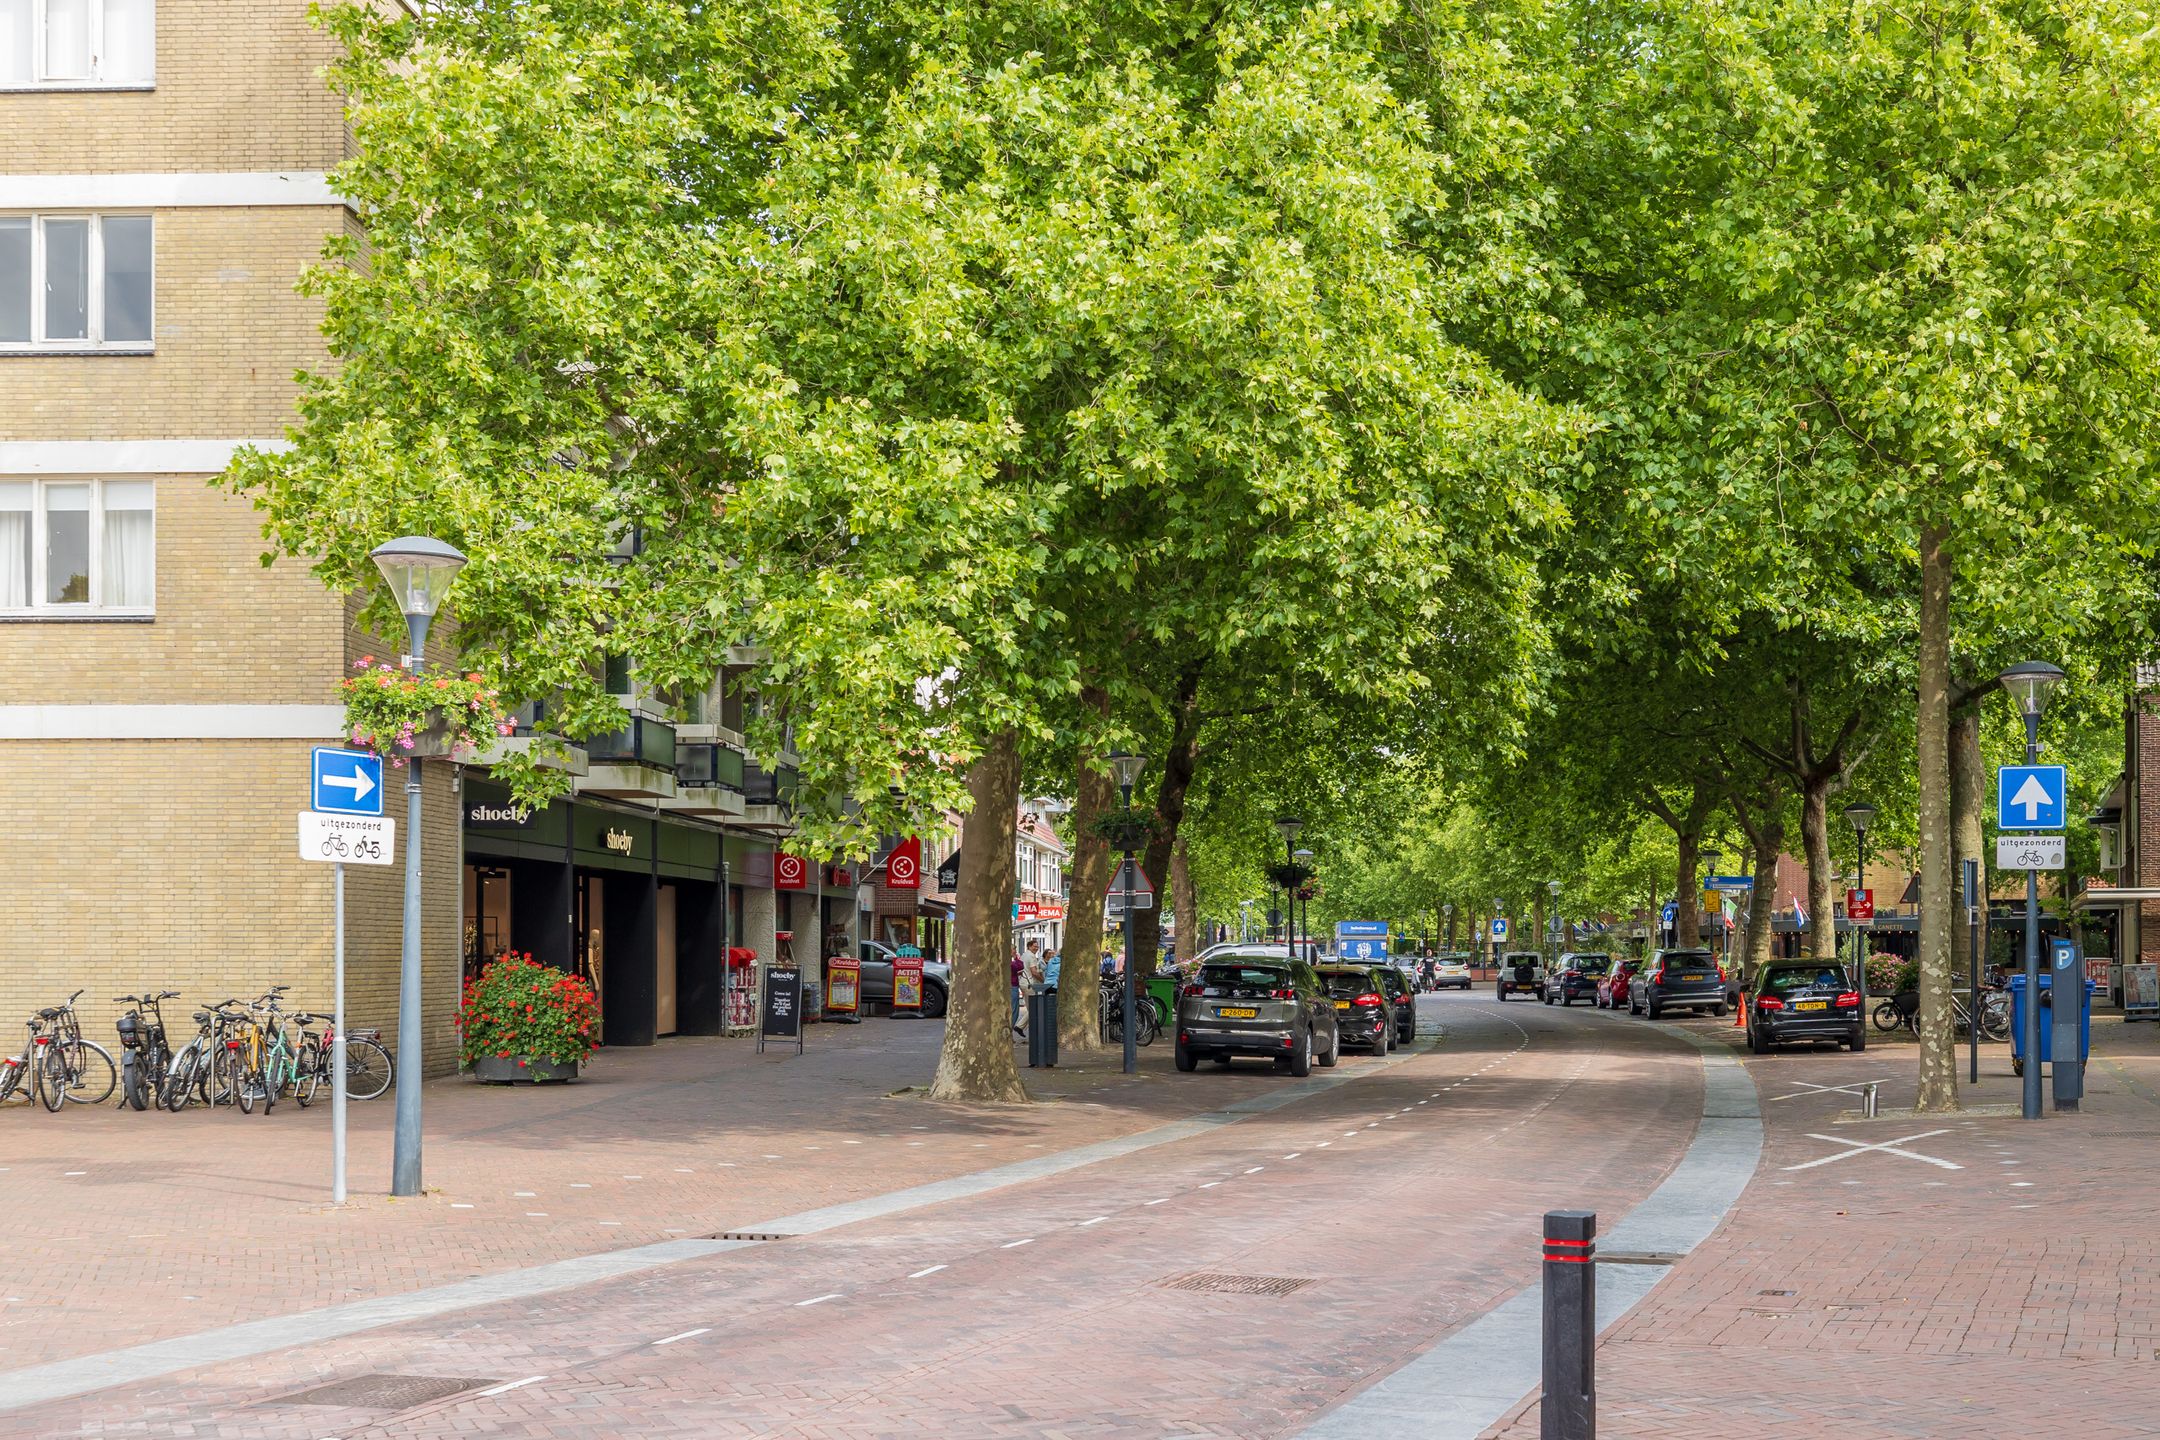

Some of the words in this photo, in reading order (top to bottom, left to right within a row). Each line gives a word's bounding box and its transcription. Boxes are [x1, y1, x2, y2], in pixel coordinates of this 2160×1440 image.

[471, 805, 531, 824] shoeby
[320, 819, 382, 831] uitgezonderd
[607, 827, 633, 856] shoeby
[2000, 839, 2062, 848] uitgezonderd
[1018, 904, 1038, 912] EMA
[770, 971, 796, 981] shoeby
